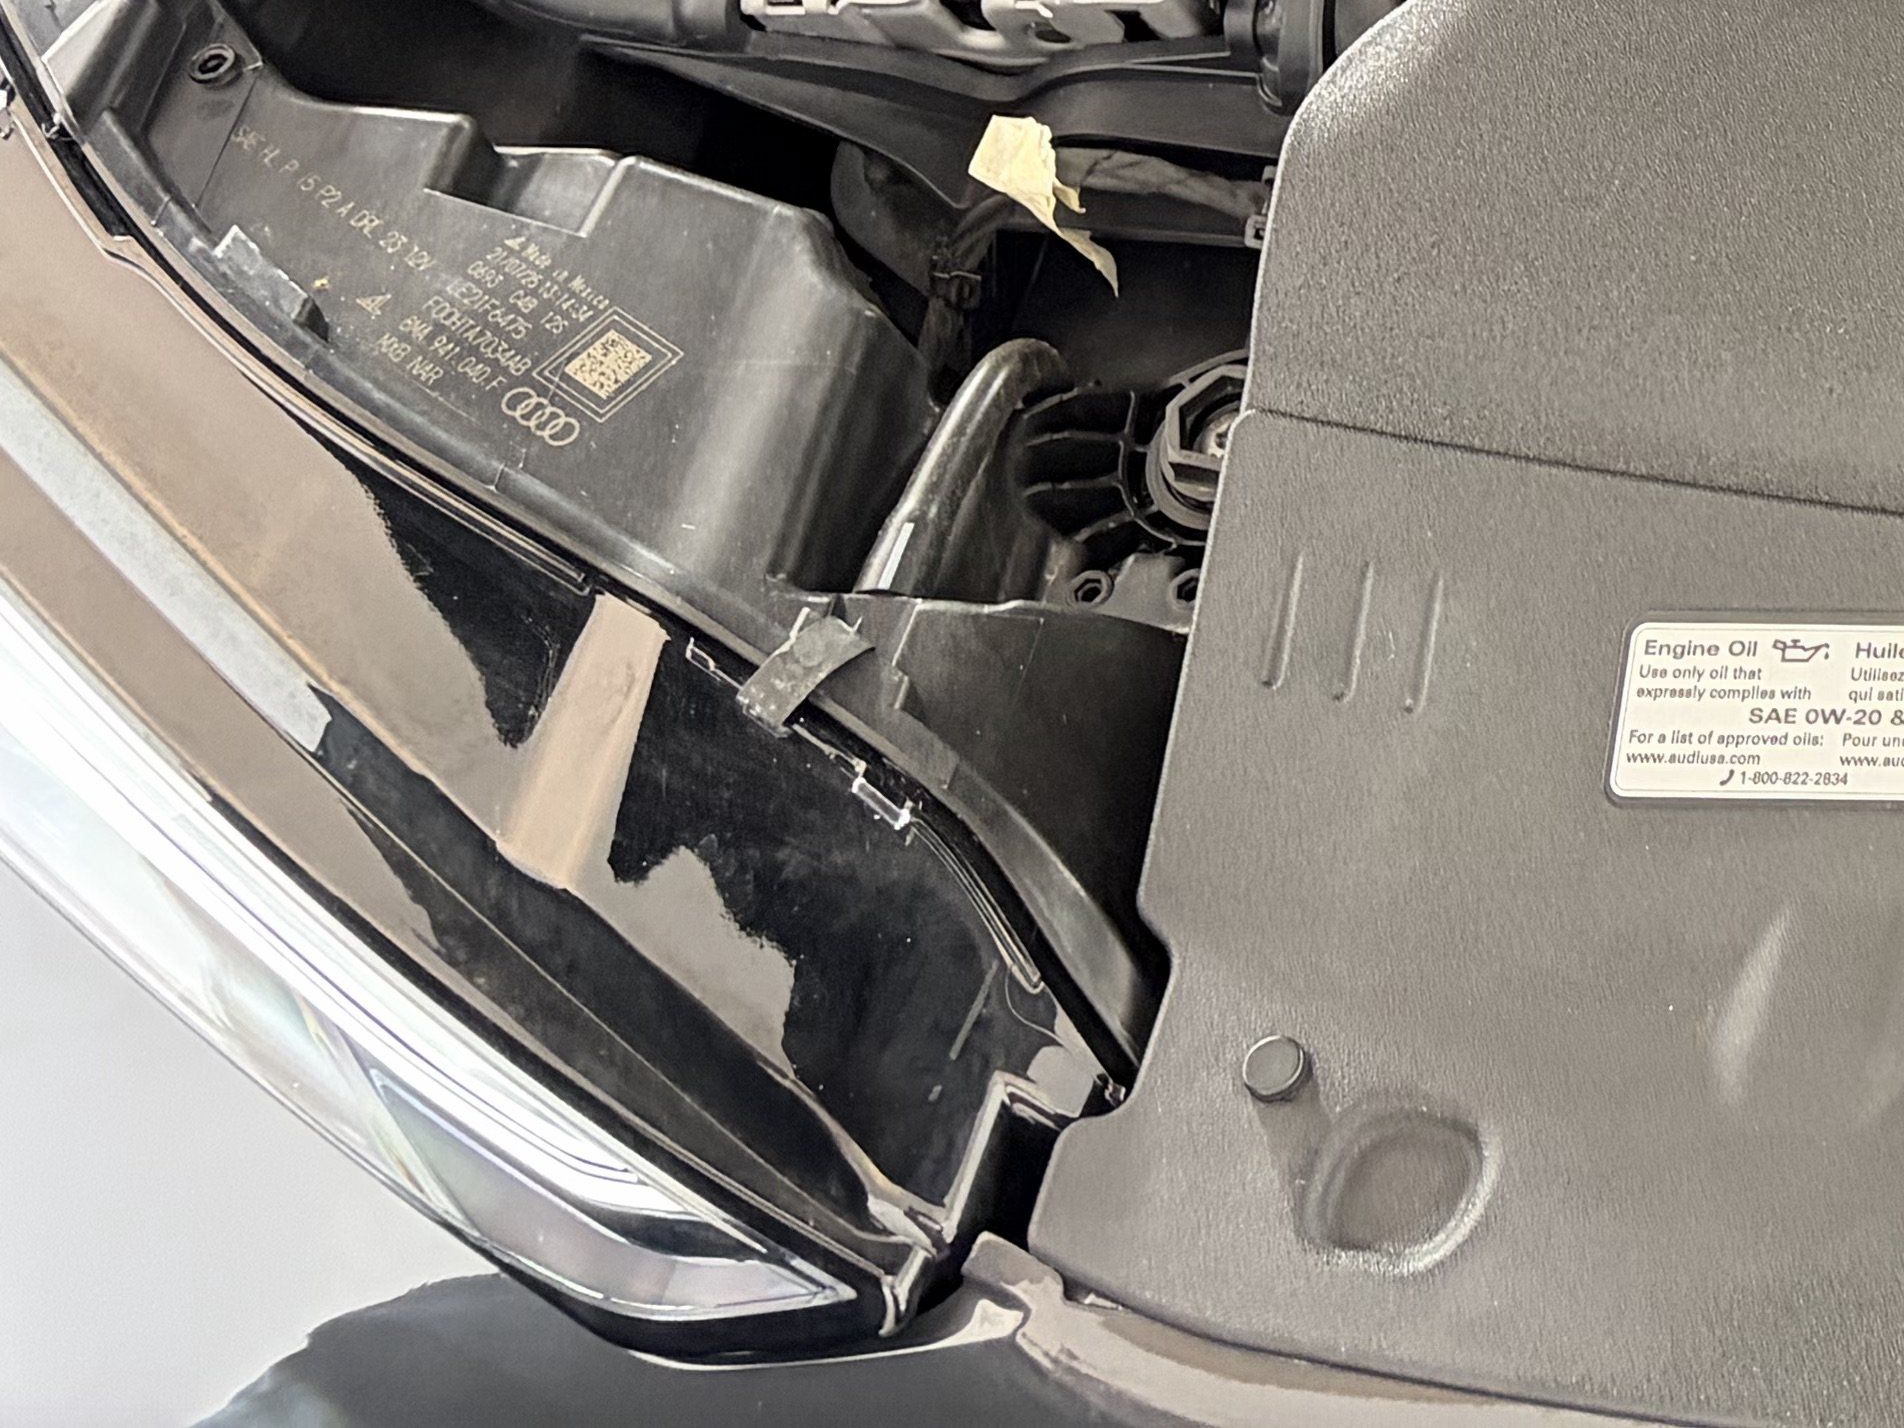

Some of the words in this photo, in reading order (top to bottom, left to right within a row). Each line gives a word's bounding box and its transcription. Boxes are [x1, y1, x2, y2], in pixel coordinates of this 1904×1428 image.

[336, 201, 356, 219] A
[1644, 639, 1720, 660] Engine
[1728, 640, 1758, 657] Oil
[1639, 664, 1668, 679] Use
[1672, 665, 1705, 683] only
[1709, 665, 1729, 680] oil
[1733, 665, 1762, 681] that
[1850, 666, 1904, 683] Utilisez
[1636, 684, 1706, 702] expressly
[1709, 685, 1776, 703] complies
[1780, 685, 1812, 700] with
[1848, 686, 1873, 704] qui
[1748, 707, 1798, 725] SAE
[1805, 708, 1882, 726] 0W-20
[1628, 729, 1654, 744] For
[1657, 733, 1667, 745] a
[1671, 729, 1693, 745] list
[1697, 730, 1714, 745] of
[1716, 731, 1789, 749] approved
[1792, 731, 1824, 747] oils:
[1842, 732, 1878, 747] Pour
[1626, 750, 1761, 766] www.audiusa.com
[1740, 770, 1848, 786] 1-800-822-2834
